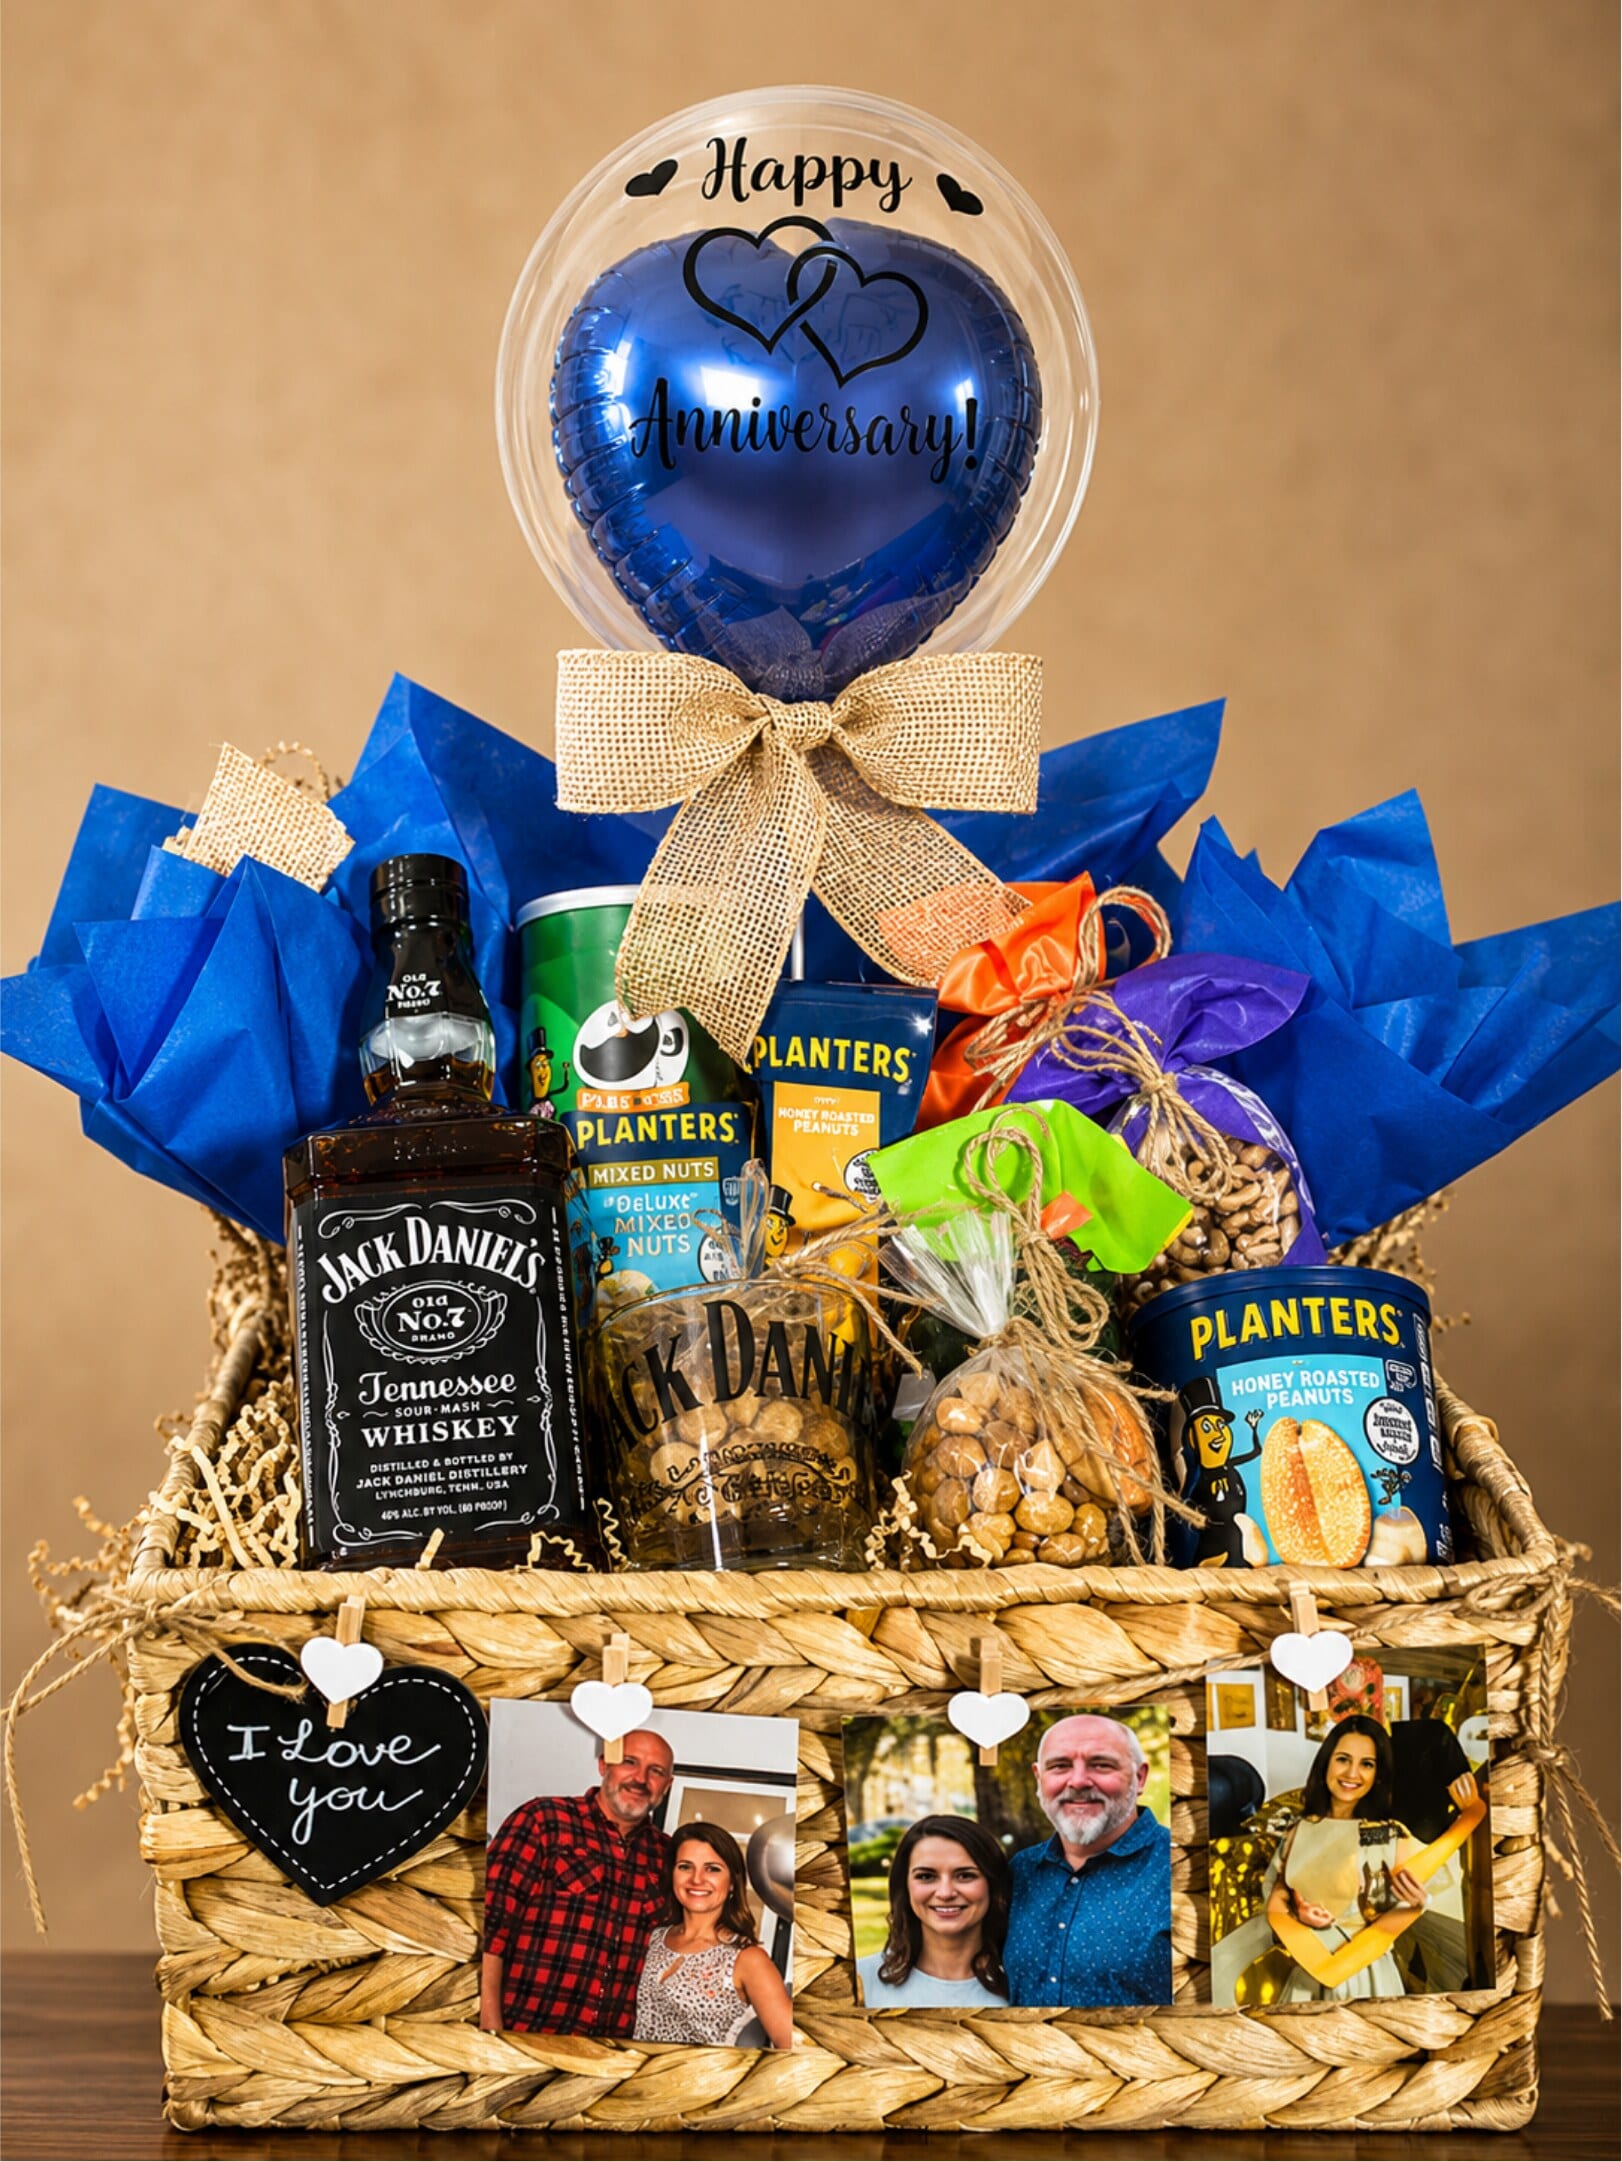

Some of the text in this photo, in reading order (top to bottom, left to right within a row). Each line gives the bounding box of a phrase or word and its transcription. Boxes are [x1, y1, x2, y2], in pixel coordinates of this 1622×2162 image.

[701, 136, 912, 213] Happy
[628, 377, 978, 484] Anniversary!
[752, 1035, 911, 1084] PLANTERS
[576, 1112, 736, 1150] PLANTERS
[778, 1107, 876, 1124] HONEY ROASTED
[793, 1119, 859, 1137] PEANUTS
[593, 1161, 714, 1185] MIXED NUTS
[614, 1212, 691, 1234] MIXED
[317, 1215, 546, 1304] JACK DANIEL'S
[627, 1234, 691, 1258] NUTS
[1190, 1297, 1401, 1361] PLANTERS
[358, 1371, 518, 1406] Tennessee
[1231, 1371, 1294, 1396] HONEY
[1301, 1370, 1380, 1388] ROASTED
[1267, 1388, 1354, 1410] PEANUTS
[361, 1415, 519, 1449] WHISKEY
[356, 1464, 529, 1489] JACK DANIEL DISTILLERY
[370, 1458, 430, 1474] DISTILLED
[444, 1453, 496, 1466] BOTTLED
[498, 1452, 514, 1462] BY
[226, 1719, 442, 1768] I Love
[288, 1778, 424, 1846] you
